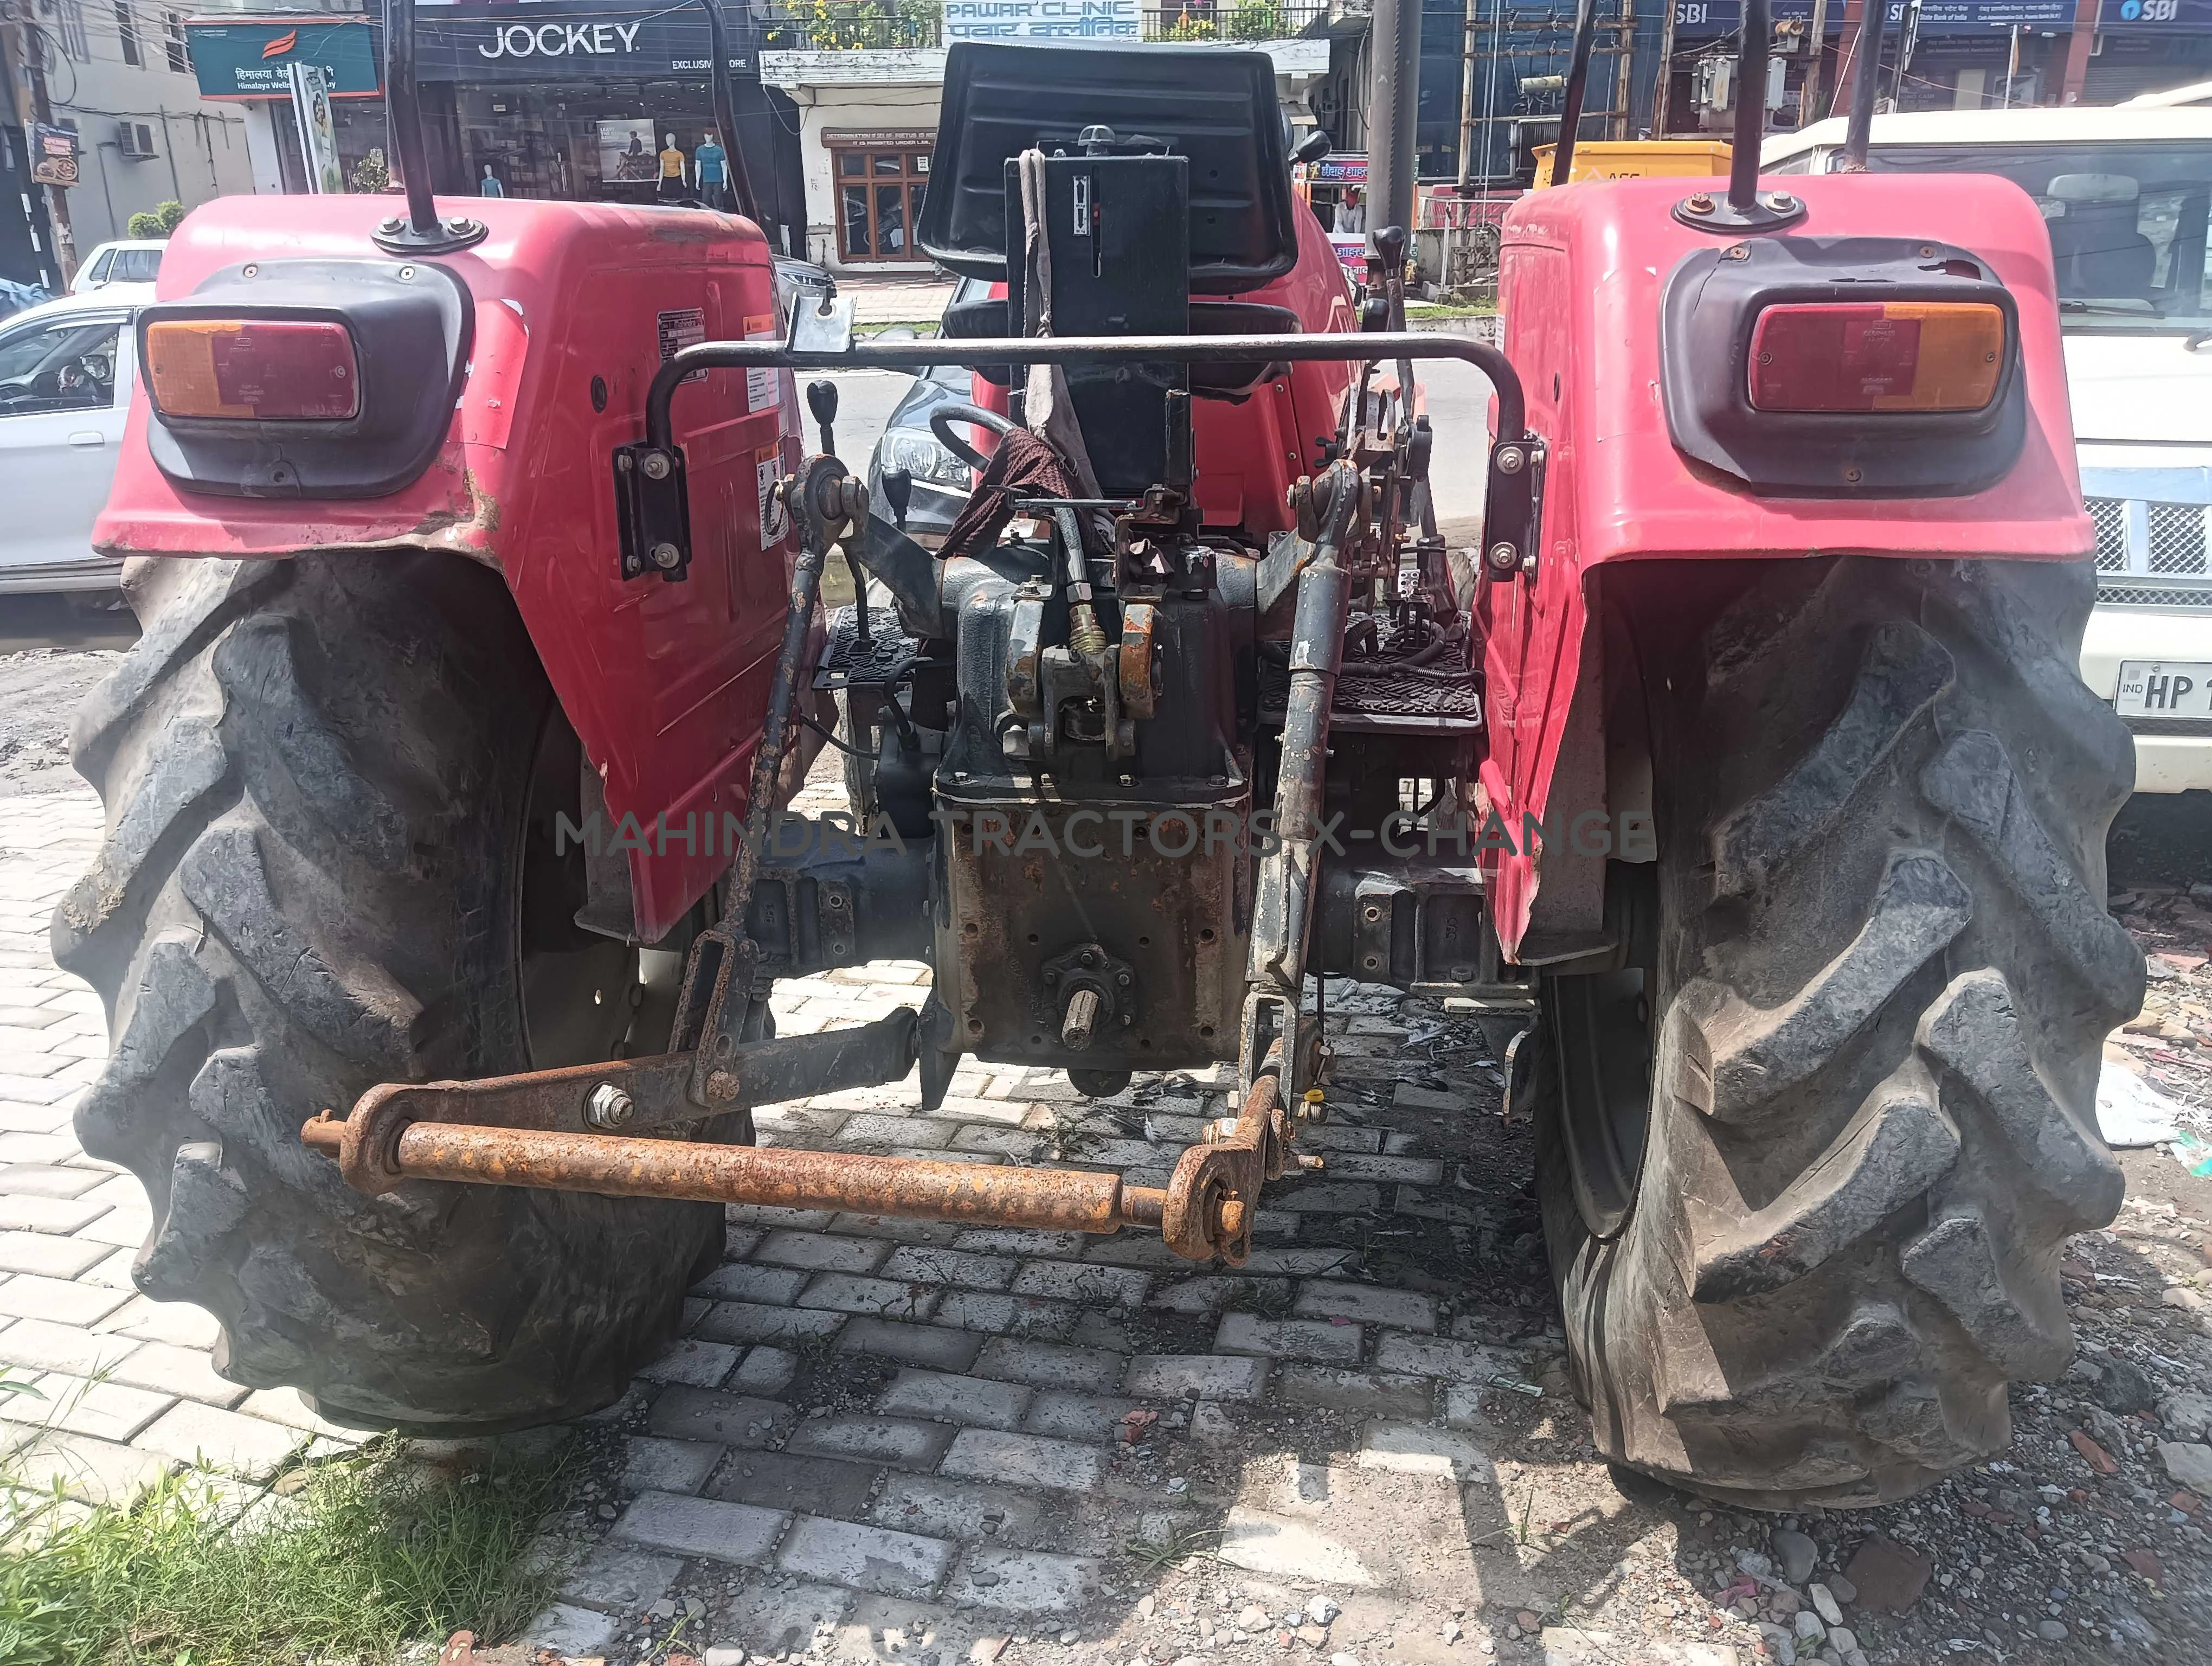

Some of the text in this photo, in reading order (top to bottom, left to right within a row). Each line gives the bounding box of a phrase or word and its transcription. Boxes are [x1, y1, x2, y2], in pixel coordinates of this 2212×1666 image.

[947, 1, 1135, 18] PAWAR CLINIC
[1676, 4, 1707, 24] SBI
[2141, 1, 2178, 21] SBI
[948, 23, 1020, 37] पवार
[672, 59, 747, 69] EXCLUSIV ORE
[235, 67, 272, 80] हिमालया
[237, 82, 270, 91] Himalaya
[2123, 684, 2143, 694] IND
[2144, 675, 2193, 709] HP
